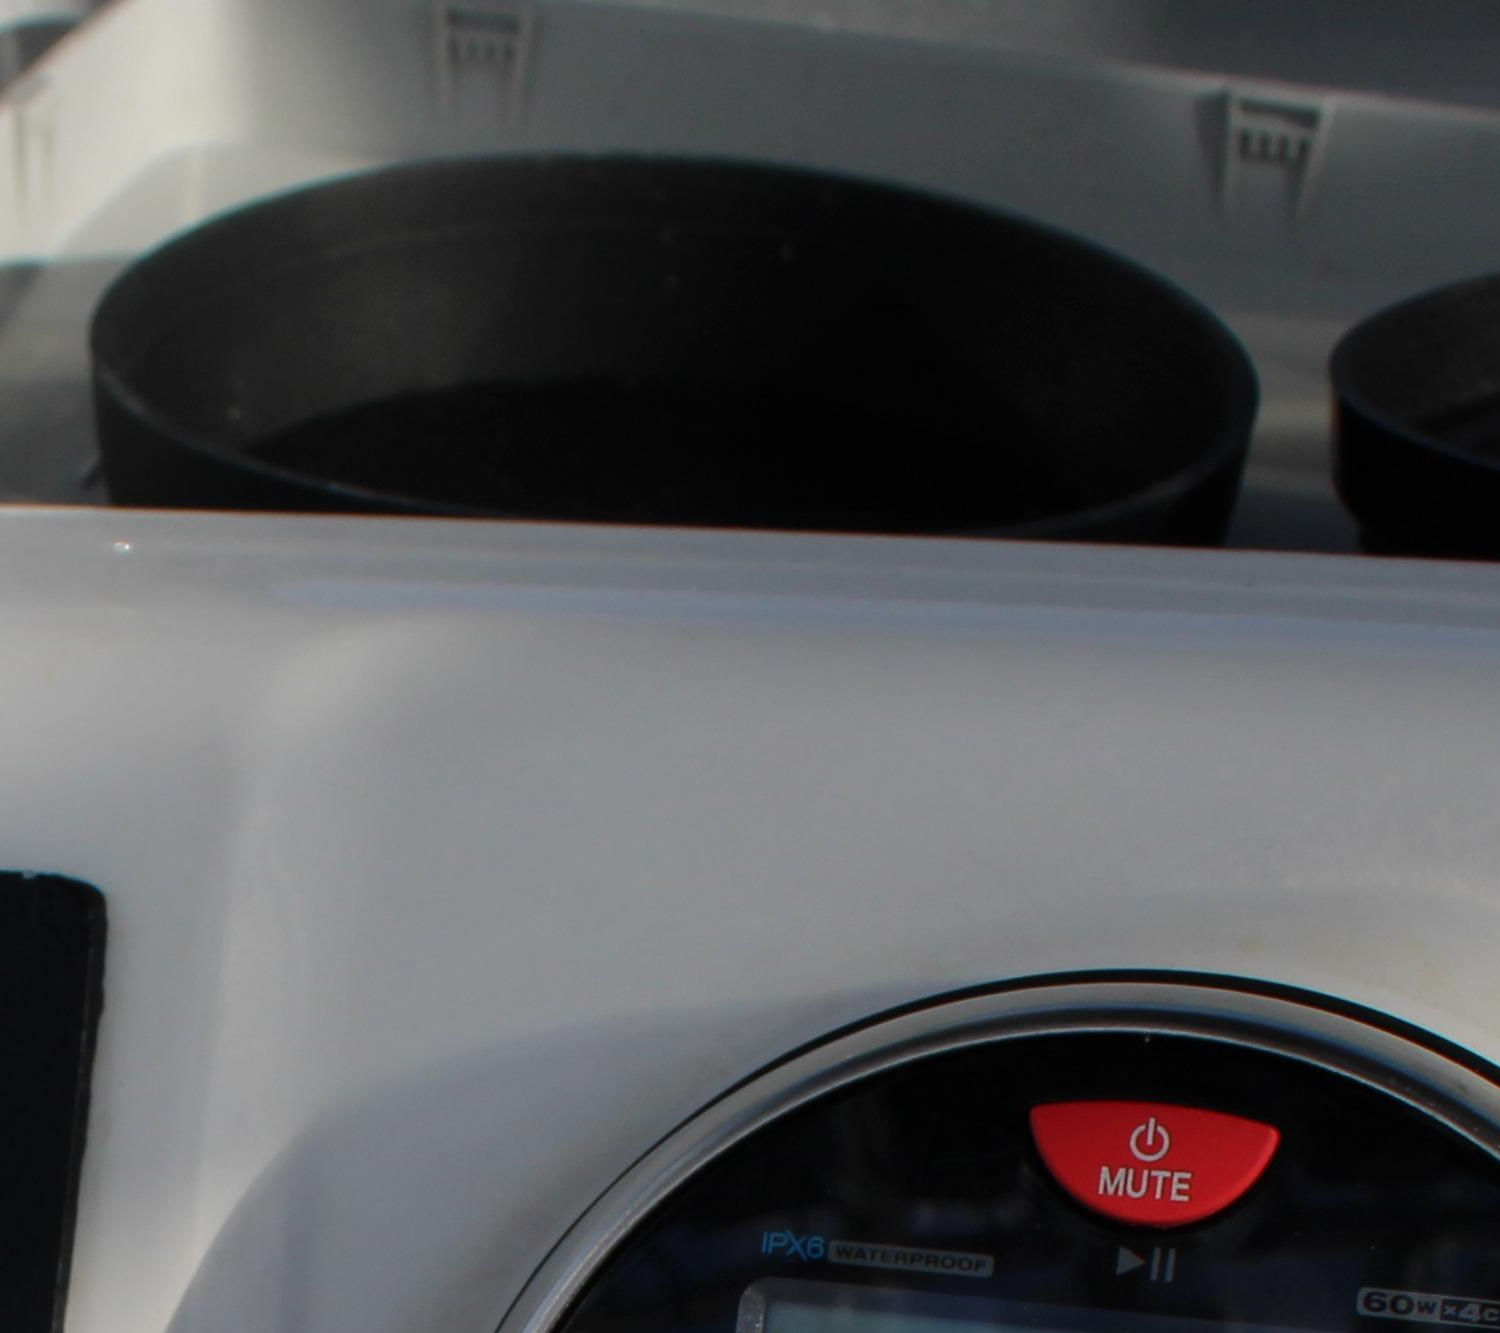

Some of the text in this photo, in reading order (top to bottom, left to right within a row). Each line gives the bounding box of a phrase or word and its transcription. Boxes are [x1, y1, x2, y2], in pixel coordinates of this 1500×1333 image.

[1098, 1165, 1191, 1203] MUTE
[761, 1229, 988, 1275] IPX6 WATERPROOF
